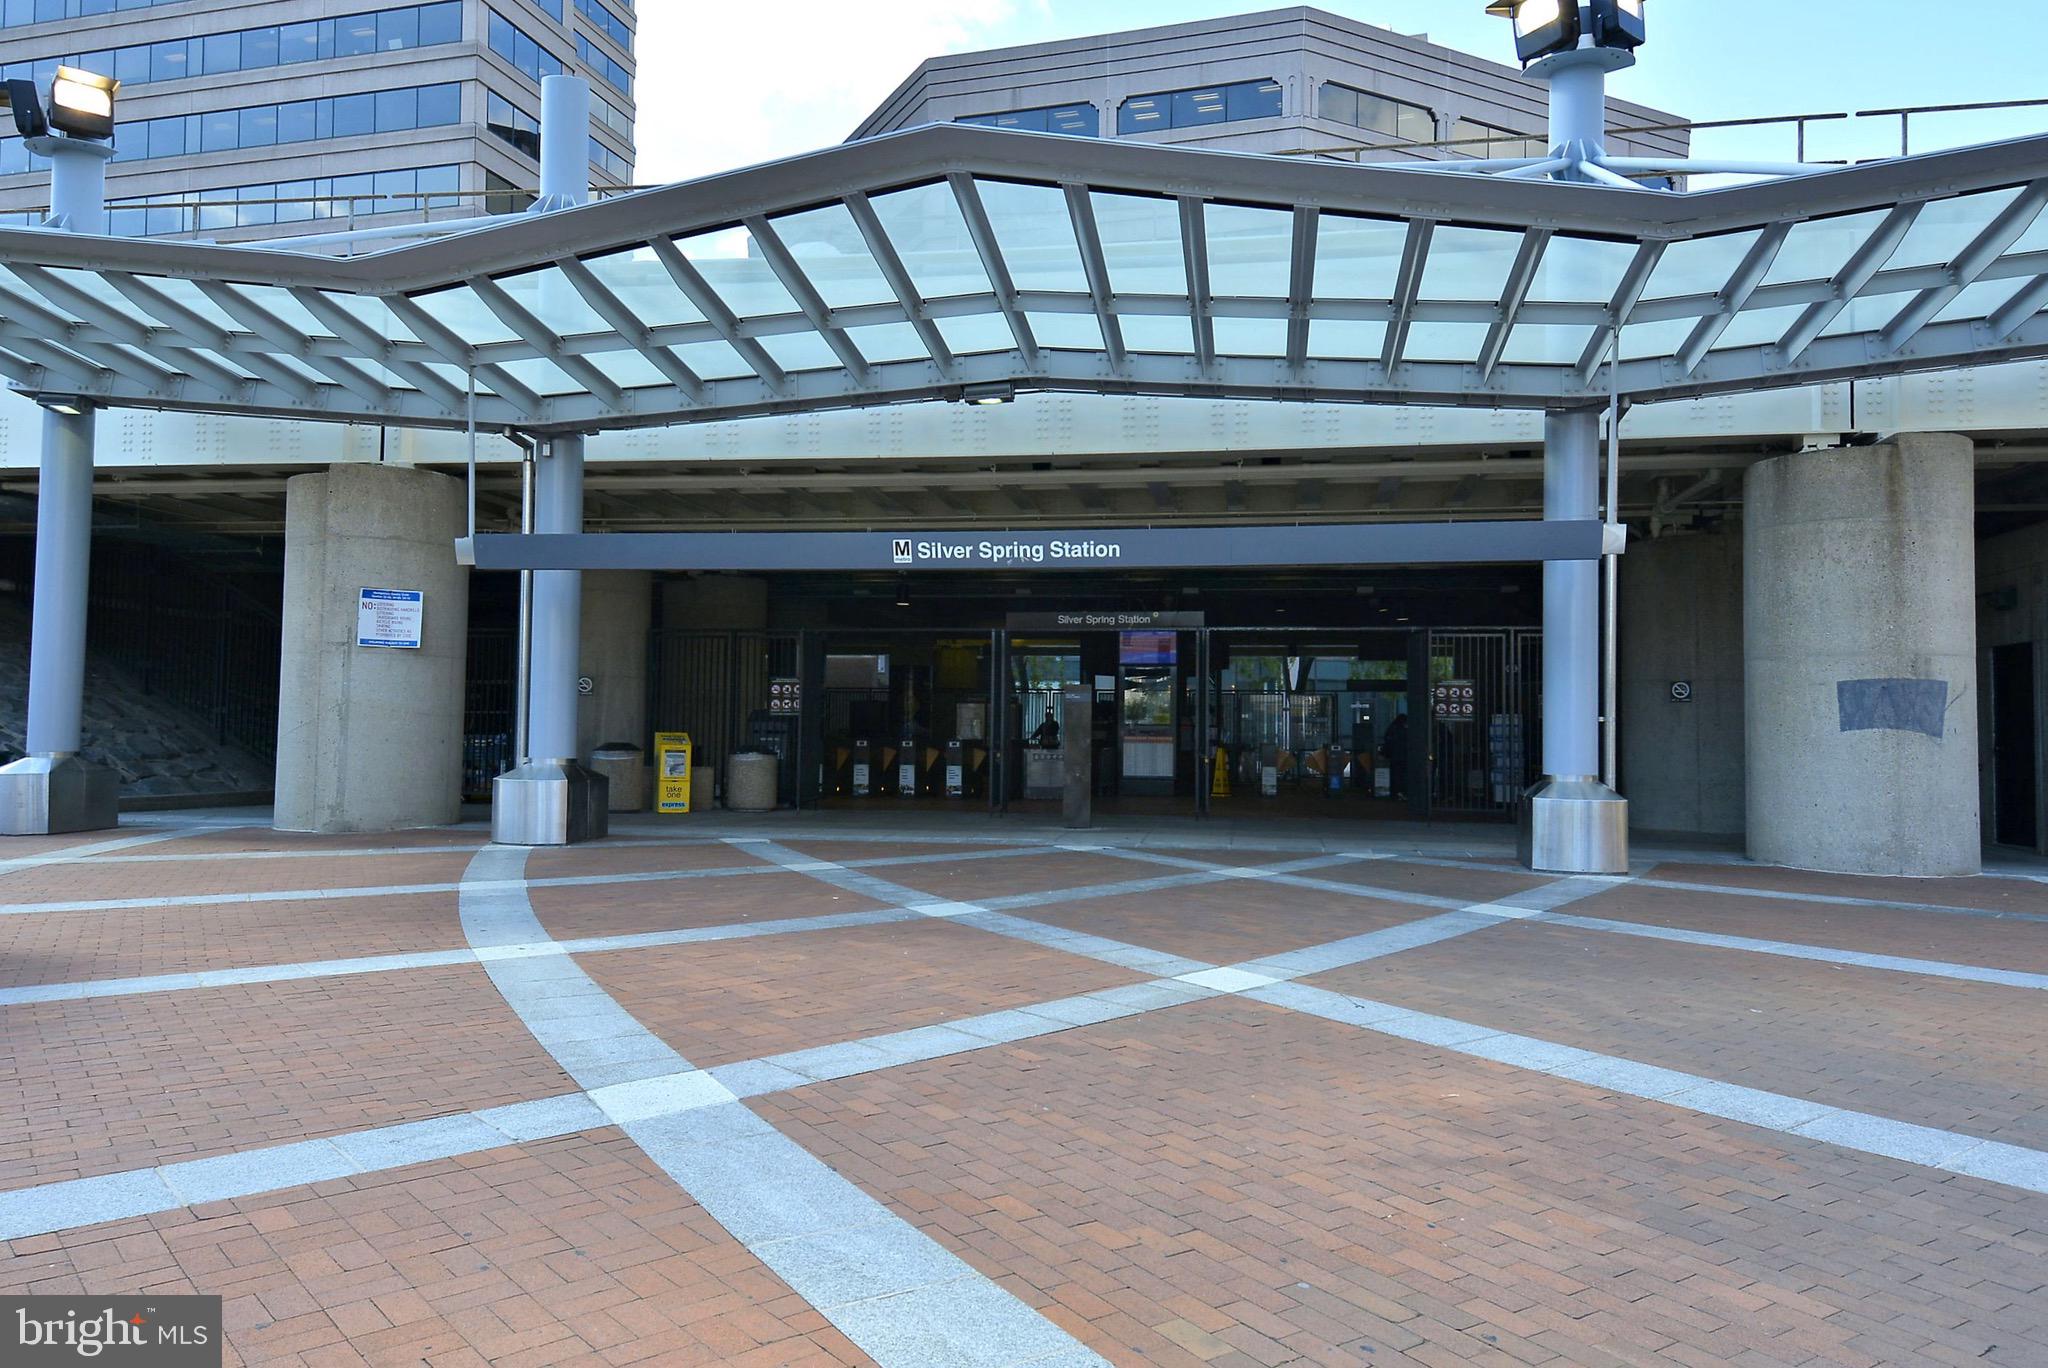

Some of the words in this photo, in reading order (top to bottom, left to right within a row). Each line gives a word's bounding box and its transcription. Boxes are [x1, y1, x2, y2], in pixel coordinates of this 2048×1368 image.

[894, 541, 910, 556] M
[917, 542, 973, 558] Silver
[979, 541, 1044, 562] Spring
[1050, 540, 1121, 558] Station
[1057, 615, 1083, 624] Silver
[1086, 615, 1115, 626] Spring
[1118, 614, 1151, 624] Station
[666, 784, 683, 793] take
